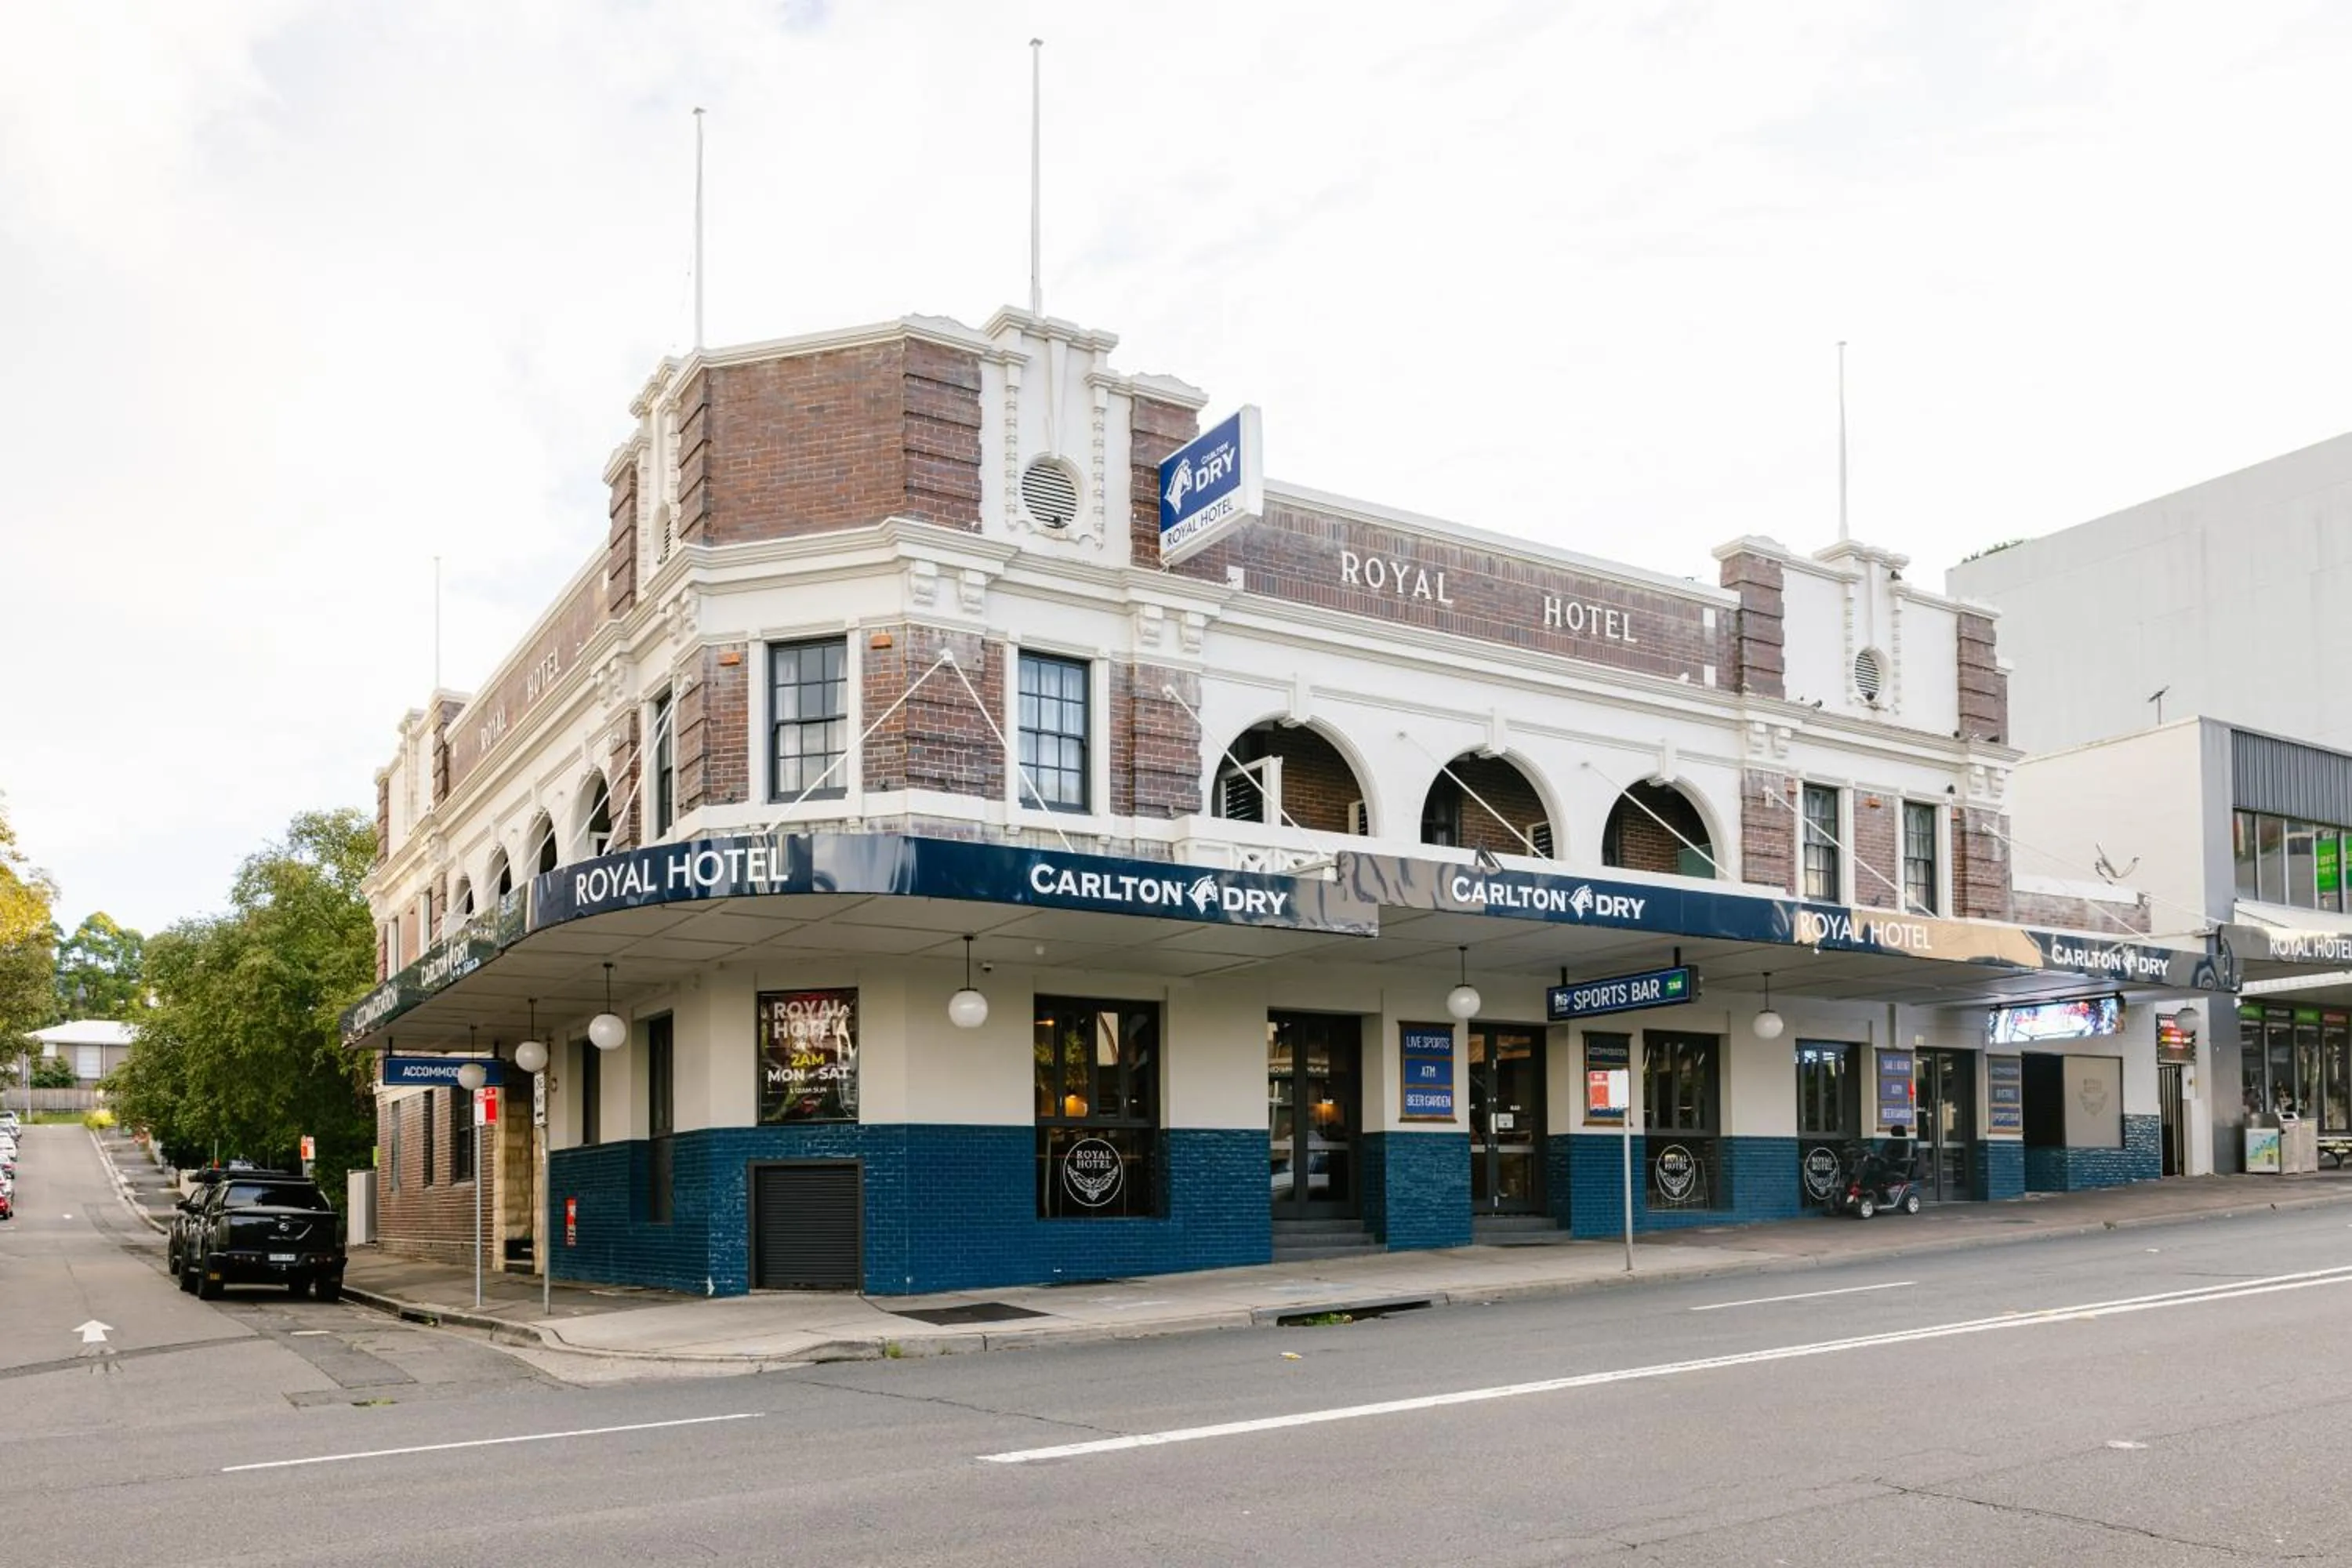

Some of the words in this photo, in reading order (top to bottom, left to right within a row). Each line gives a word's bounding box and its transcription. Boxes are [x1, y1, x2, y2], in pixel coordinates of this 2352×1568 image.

[1196, 447, 1236, 492] DRY
[1167, 518, 1197, 546] ROYAL
[1200, 498, 1233, 528] HOTEL
[1341, 551, 1454, 604] ROYAL
[1544, 596, 1638, 643] HOTEL
[527, 647, 560, 702] HOTEL
[576, 859, 657, 906] ROYAL
[668, 848, 789, 889] HOTEL
[1030, 863, 1182, 906] CARLTON
[1223, 887, 1287, 915] DRY
[1451, 877, 1566, 912] CARLTON
[1595, 895, 1646, 919] DRY
[1801, 911, 1864, 942] ROYAL
[1871, 920, 1933, 950] HOTEL
[454, 940, 469, 966] DRY
[2270, 935, 2312, 957] ROYAL
[2314, 938, 2352, 959] HOTEL
[2051, 945, 2122, 971] CARLTON
[2138, 957, 2170, 977] DRY
[1573, 984, 1627, 1010] SPORTS
[1632, 979, 1660, 1001] BAR
[774, 1000, 840, 1019] ROYAL
[774, 1020, 839, 1039] HOTEL
[1406, 1036, 1421, 1048] LIVE
[1423, 1036, 1450, 1050] SPORTS
[402, 1066, 459, 1078] ACCOMMOD
[790, 1054, 825, 1066] 2AM
[1421, 1066, 1436, 1078] ATM
[768, 1069, 805, 1082] MON
[818, 1067, 850, 1080] SAT
[1407, 1094, 1425, 1106] BEER
[1076, 1150, 1112, 1160] ROYAL
[1076, 1160, 1112, 1169] HOTEL
